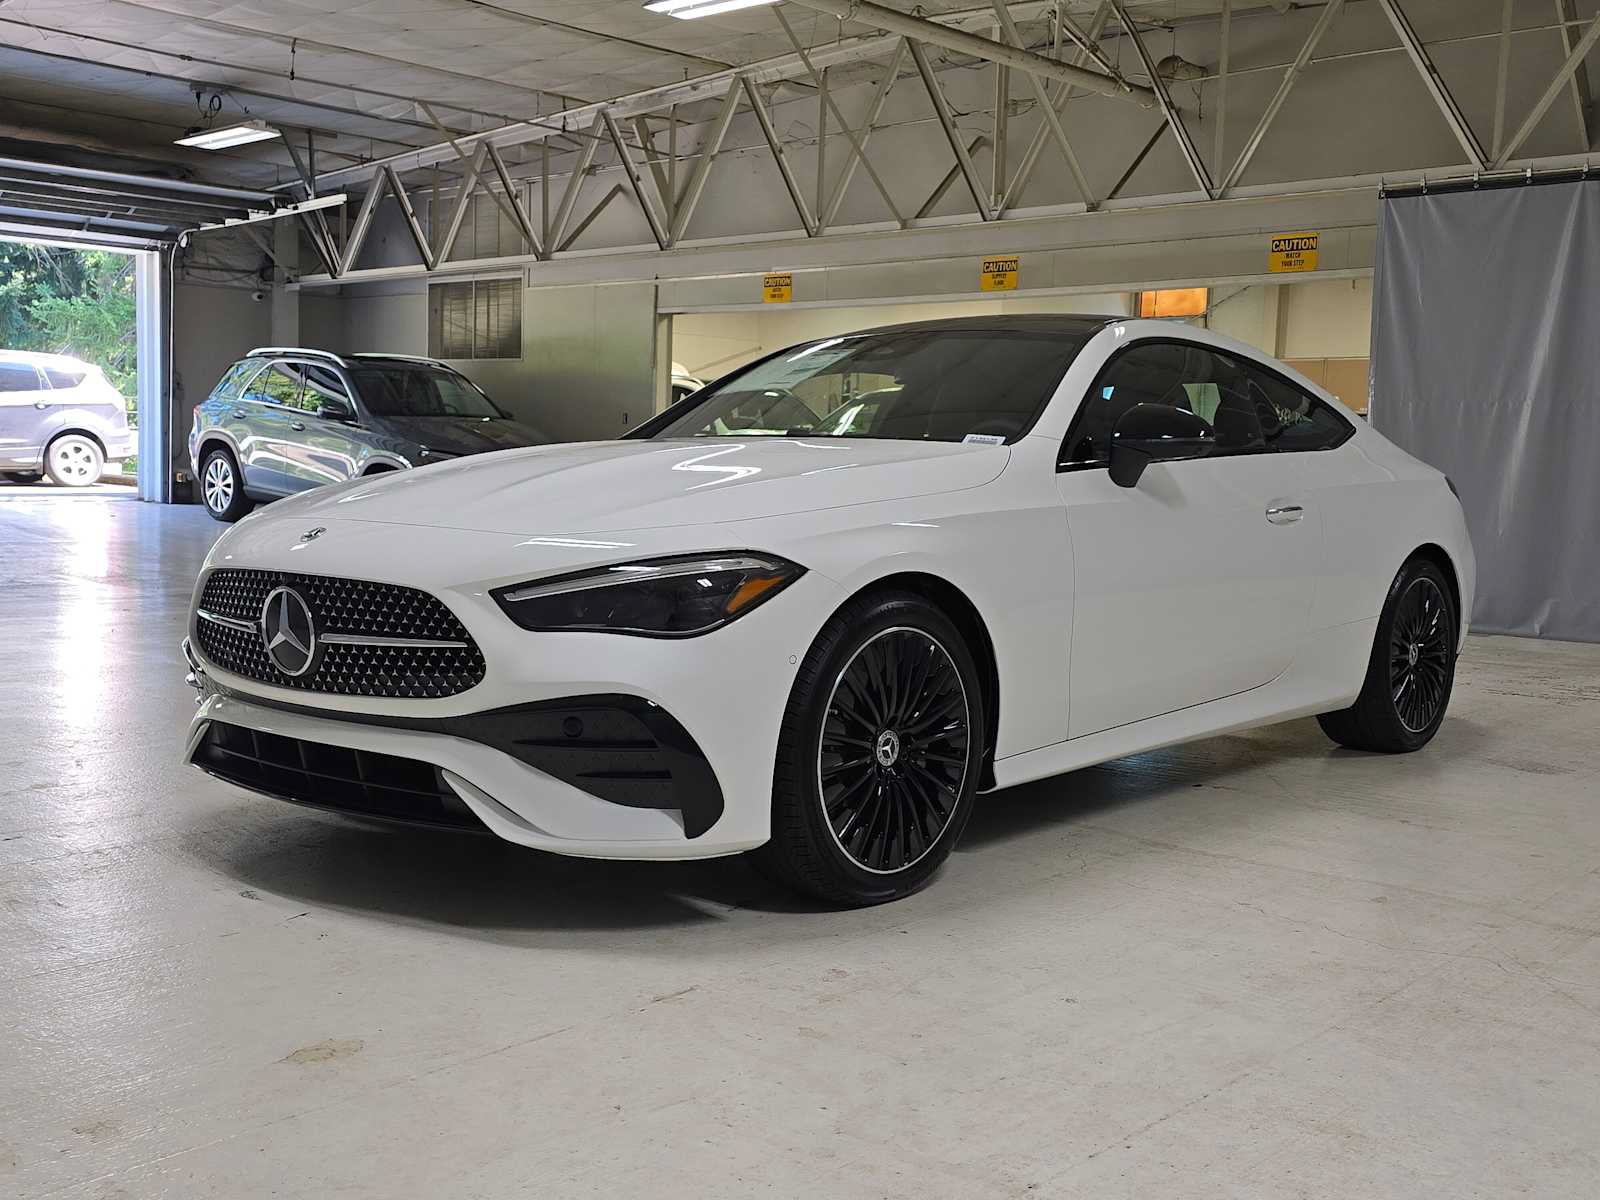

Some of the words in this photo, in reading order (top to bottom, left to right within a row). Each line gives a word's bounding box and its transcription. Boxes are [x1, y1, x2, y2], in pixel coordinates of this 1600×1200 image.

[1273, 238, 1316, 251] CAUTION
[984, 261, 1016, 272] CAUTION
[765, 278, 791, 286] CAUTION
